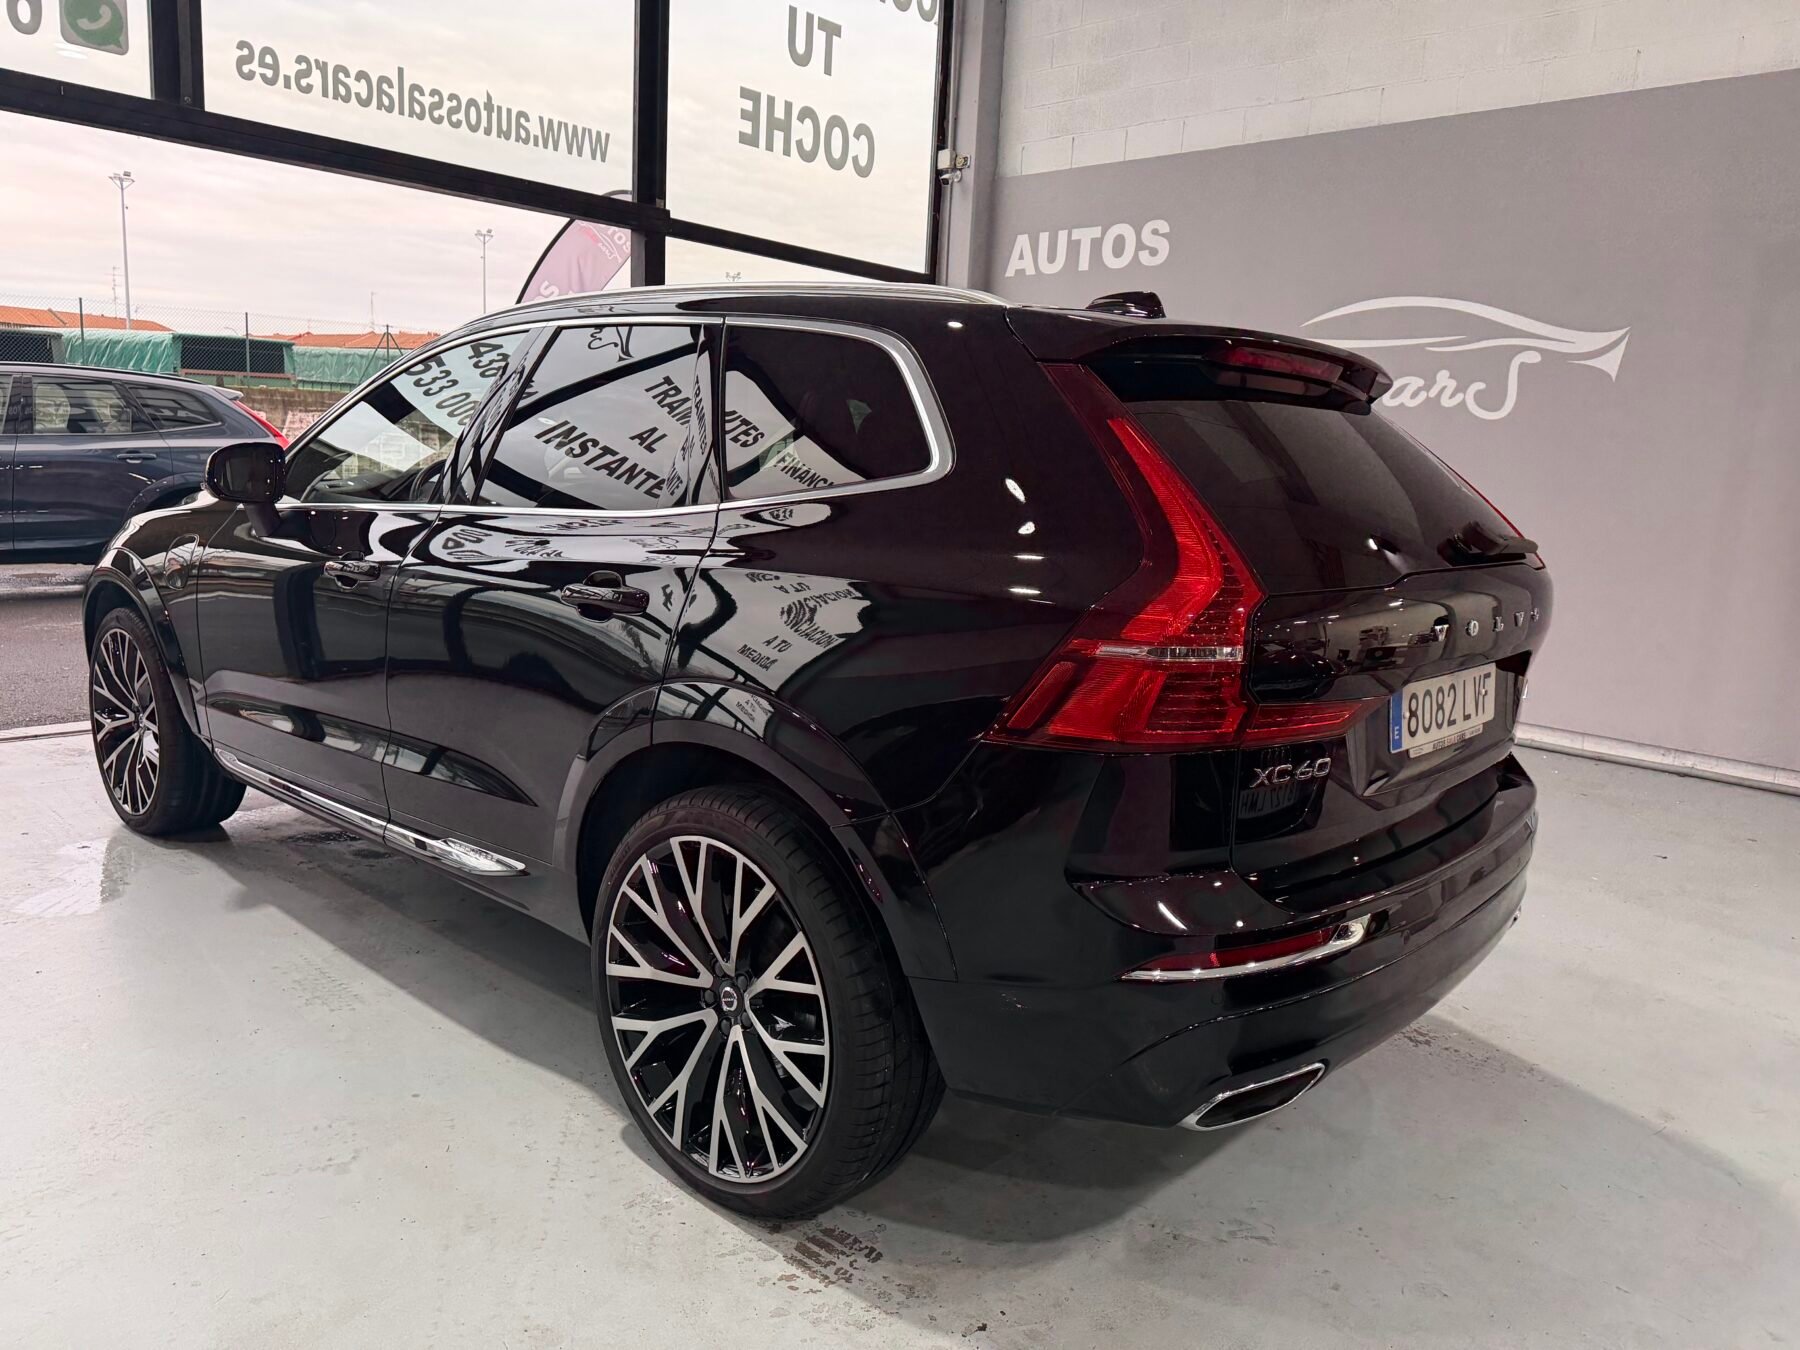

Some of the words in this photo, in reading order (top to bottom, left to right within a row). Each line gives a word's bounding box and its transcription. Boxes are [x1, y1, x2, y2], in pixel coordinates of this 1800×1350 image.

[1005, 219, 1170, 277] AUTOS
[534, 420, 667, 499] INSTANTE
[629, 426, 668, 453] AL
[1394, 726, 1400, 739] E
[1407, 682, 1457, 738] 8082
[1462, 672, 1492, 722] LVF
[1250, 757, 1332, 788] XC60
